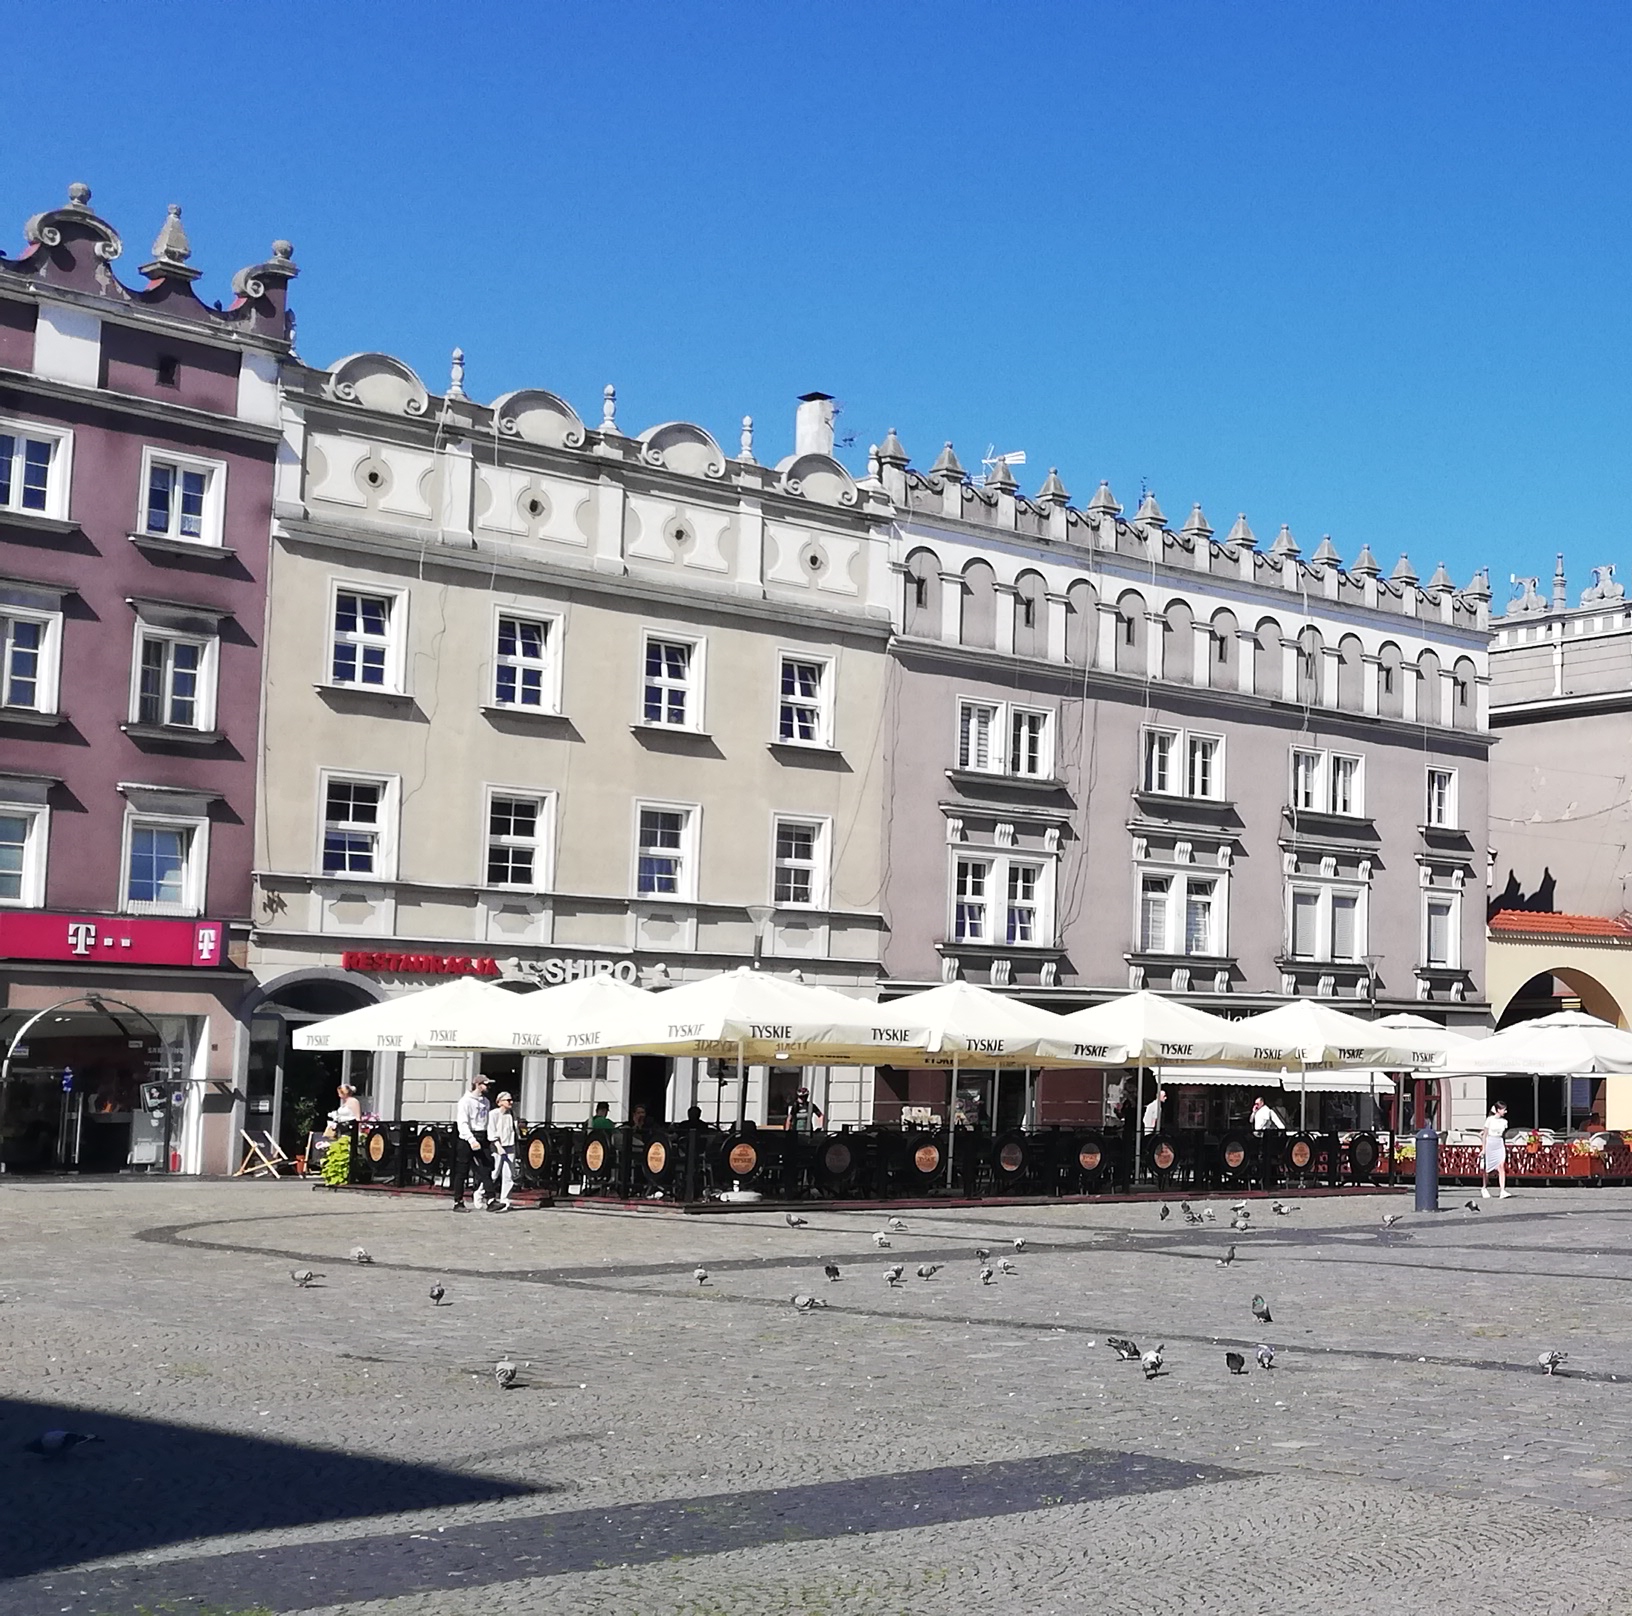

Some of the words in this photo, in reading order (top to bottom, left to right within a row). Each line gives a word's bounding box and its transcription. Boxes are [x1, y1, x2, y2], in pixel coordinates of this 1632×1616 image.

[341, 951, 499, 975] RESTAURACJA
[546, 958, 637, 985] SHIRO
[430, 1030, 458, 1042] TYSKIE
[512, 1032, 543, 1046] TYSKIE
[567, 1031, 601, 1047] TYSKIE
[749, 1025, 793, 1039] TYSKIE
[871, 1028, 910, 1042] TYSKIE
[306, 1034, 331, 1047] TYSKIE
[377, 1034, 403, 1047] TYSKIE
[966, 1038, 1005, 1052] TYSKIE
[1073, 1043, 1109, 1058] TYSKIE
[1160, 1043, 1193, 1056] TYSKIE
[1253, 1047, 1283, 1060] TYSKIE
[1338, 1048, 1365, 1060] TYSKIE
[1412, 1051, 1435, 1063] TYSKIE
